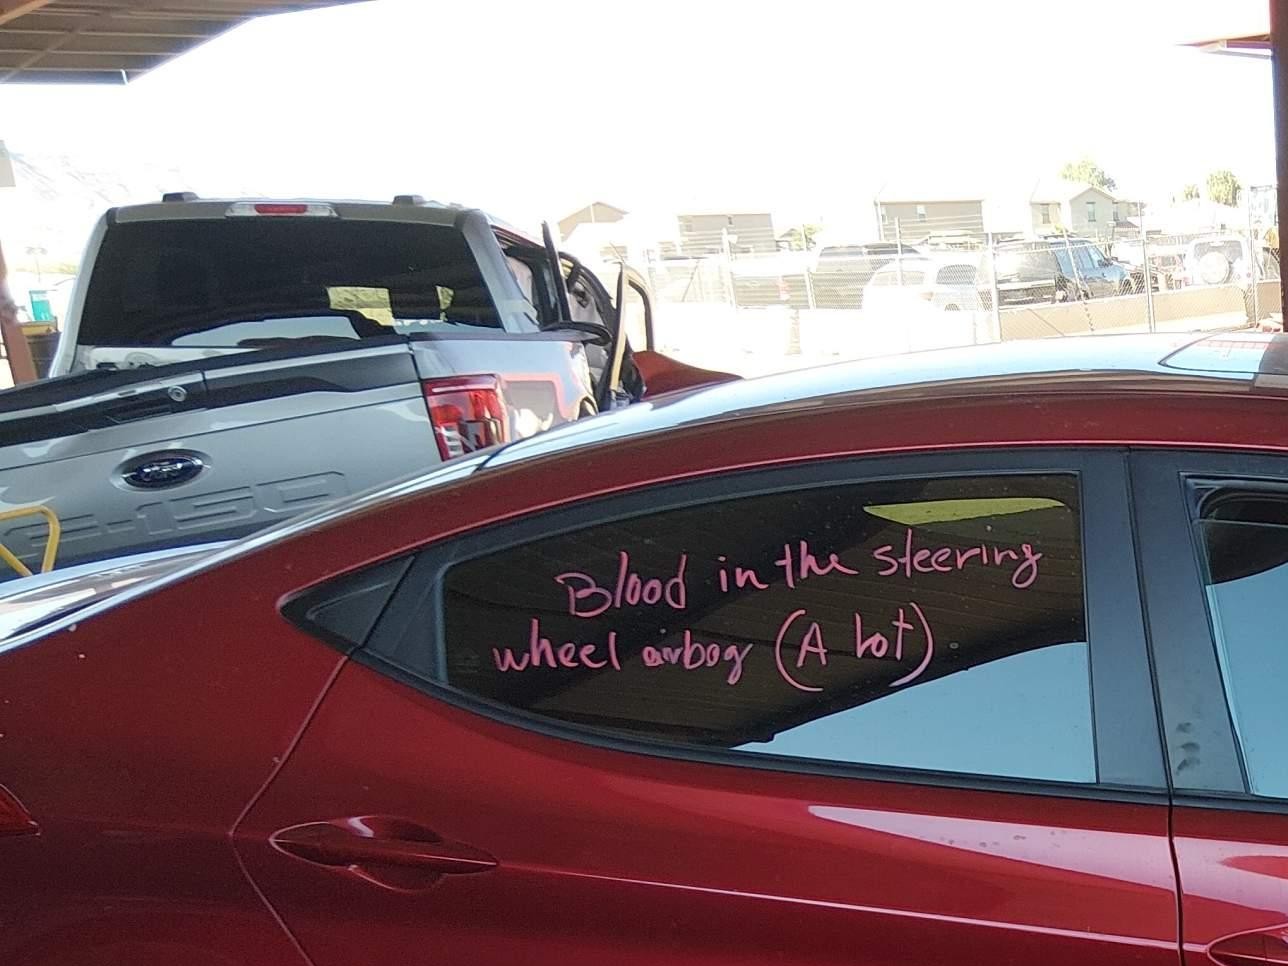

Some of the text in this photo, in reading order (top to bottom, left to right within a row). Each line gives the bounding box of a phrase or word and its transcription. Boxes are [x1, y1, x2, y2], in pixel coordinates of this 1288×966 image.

[555, 528, 1043, 617] Blood in the steering
[491, 618, 622, 672] wheel
